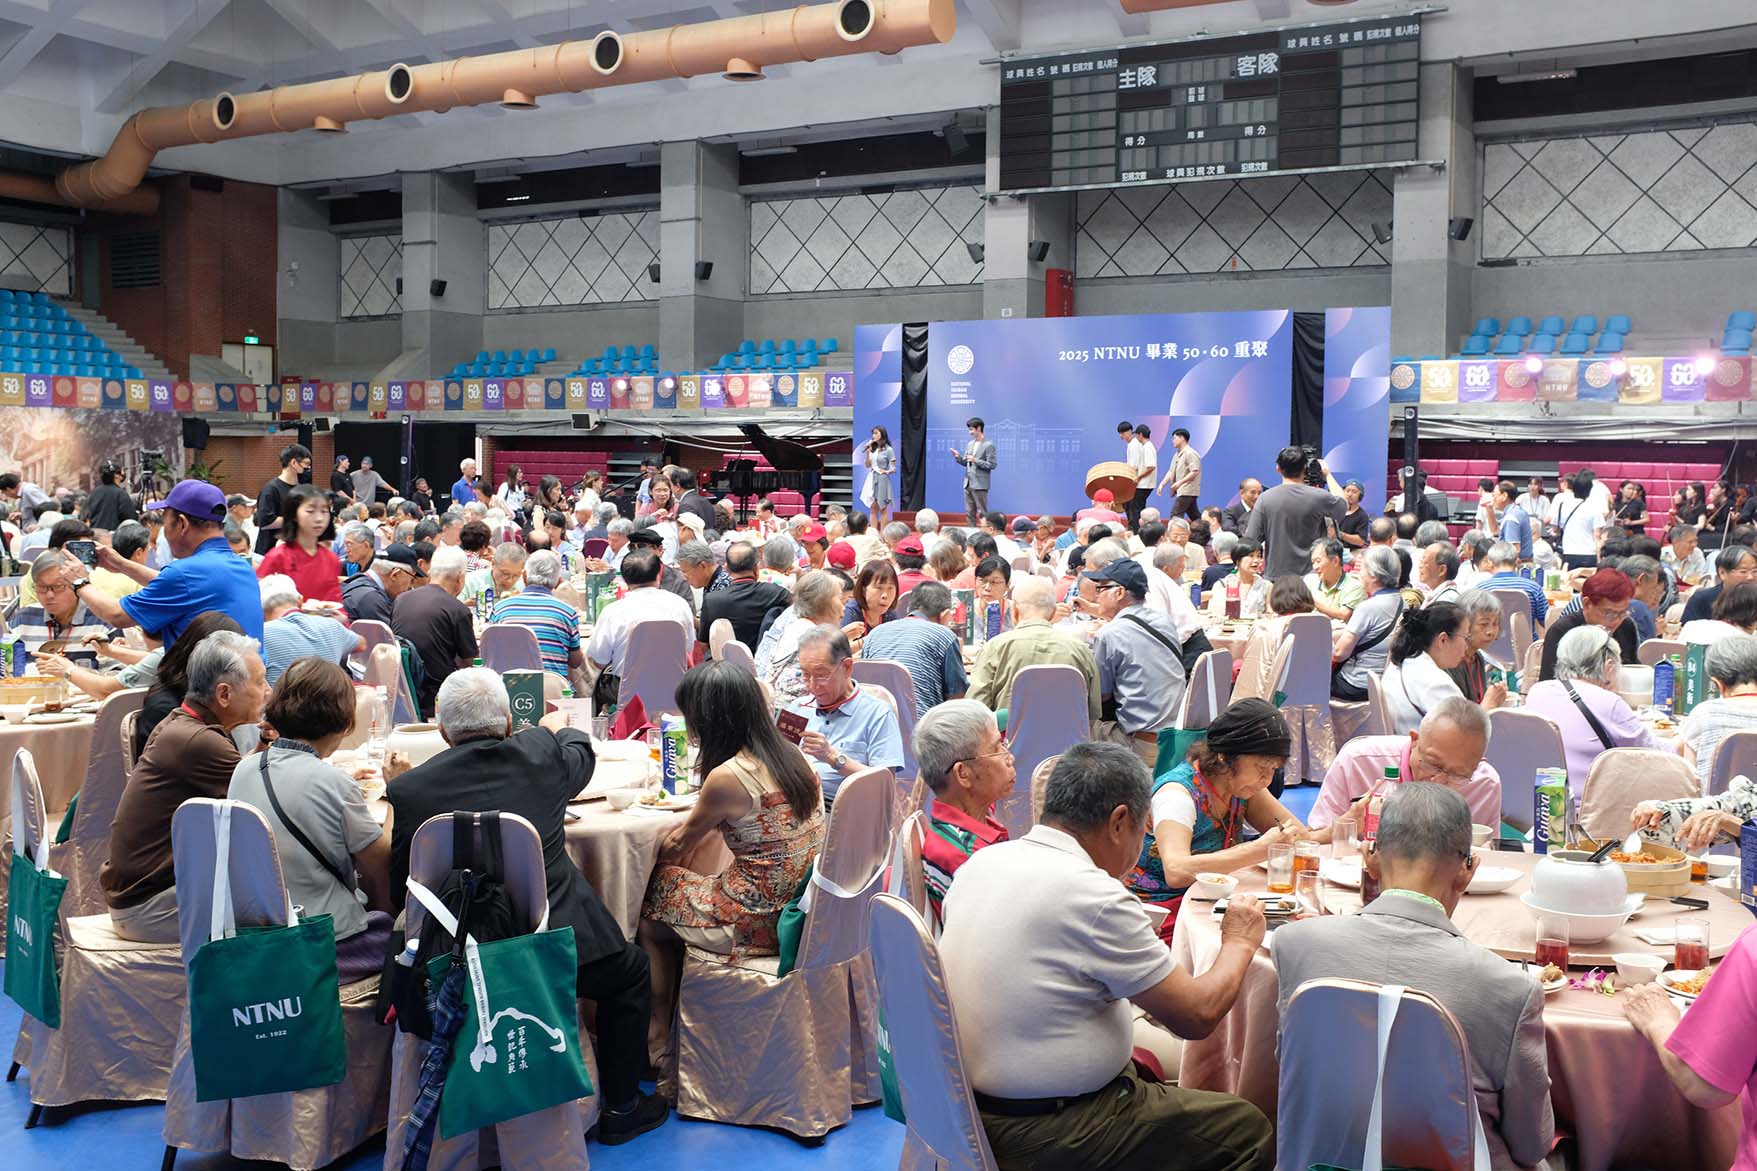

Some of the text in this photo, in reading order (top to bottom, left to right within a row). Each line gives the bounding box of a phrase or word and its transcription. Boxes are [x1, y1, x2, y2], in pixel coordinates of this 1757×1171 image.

[1287, 34, 1334, 49] 球員姓名
[1006, 66, 1045, 79] 球員姓名
[1237, 52, 1279, 77] 客隊
[1119, 65, 1157, 89] 主隊
[1244, 125, 1267, 136] 得分
[1125, 135, 1146, 147] 得分
[1166, 165, 1226, 179] 球員犯規次數
[1059, 349, 1089, 363] 2025
[1094, 346, 1140, 360] NTNU
[1146, 343, 1178, 360] 畢業
[1234, 340, 1269, 358] 重聚
[514, 697, 533, 710] C5
[666, 738, 677, 779] Guava
[1537, 794, 1550, 842] Guava
[232, 996, 302, 1028] NTNU
